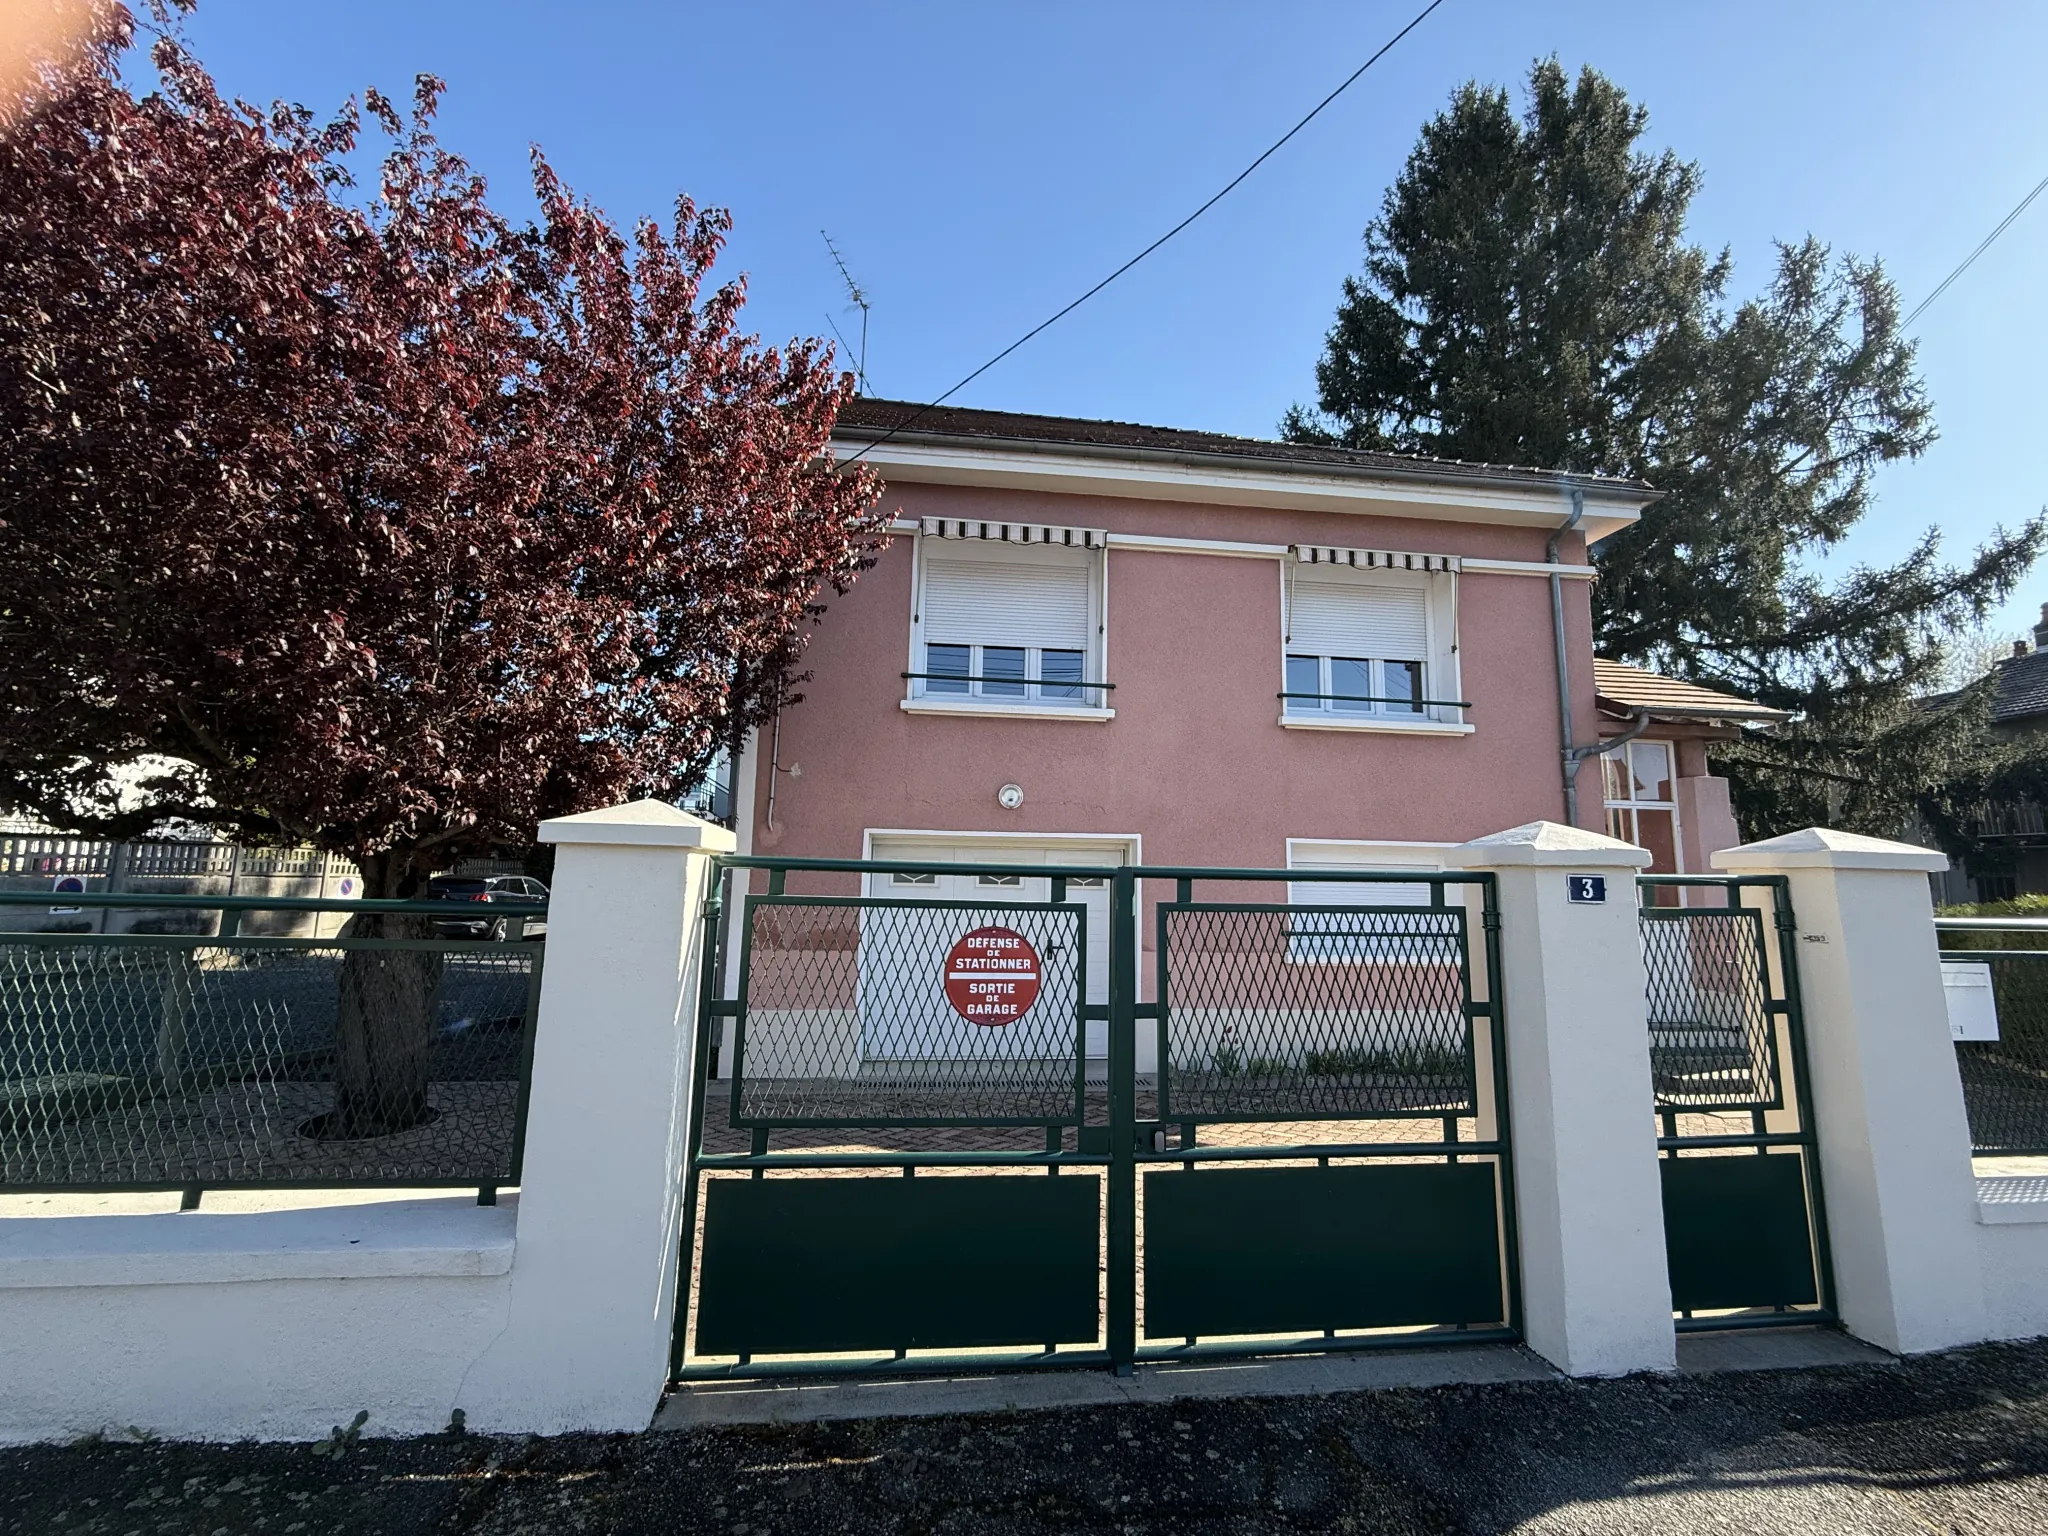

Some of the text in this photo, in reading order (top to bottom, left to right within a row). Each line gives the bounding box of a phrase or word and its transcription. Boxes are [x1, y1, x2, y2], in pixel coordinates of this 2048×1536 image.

[1582, 879, 1594, 898] 3
[956, 958, 1031, 969] STATIONNER
[969, 983, 1015, 994] SORTIE
[967, 1004, 1018, 1015] GARAGE
